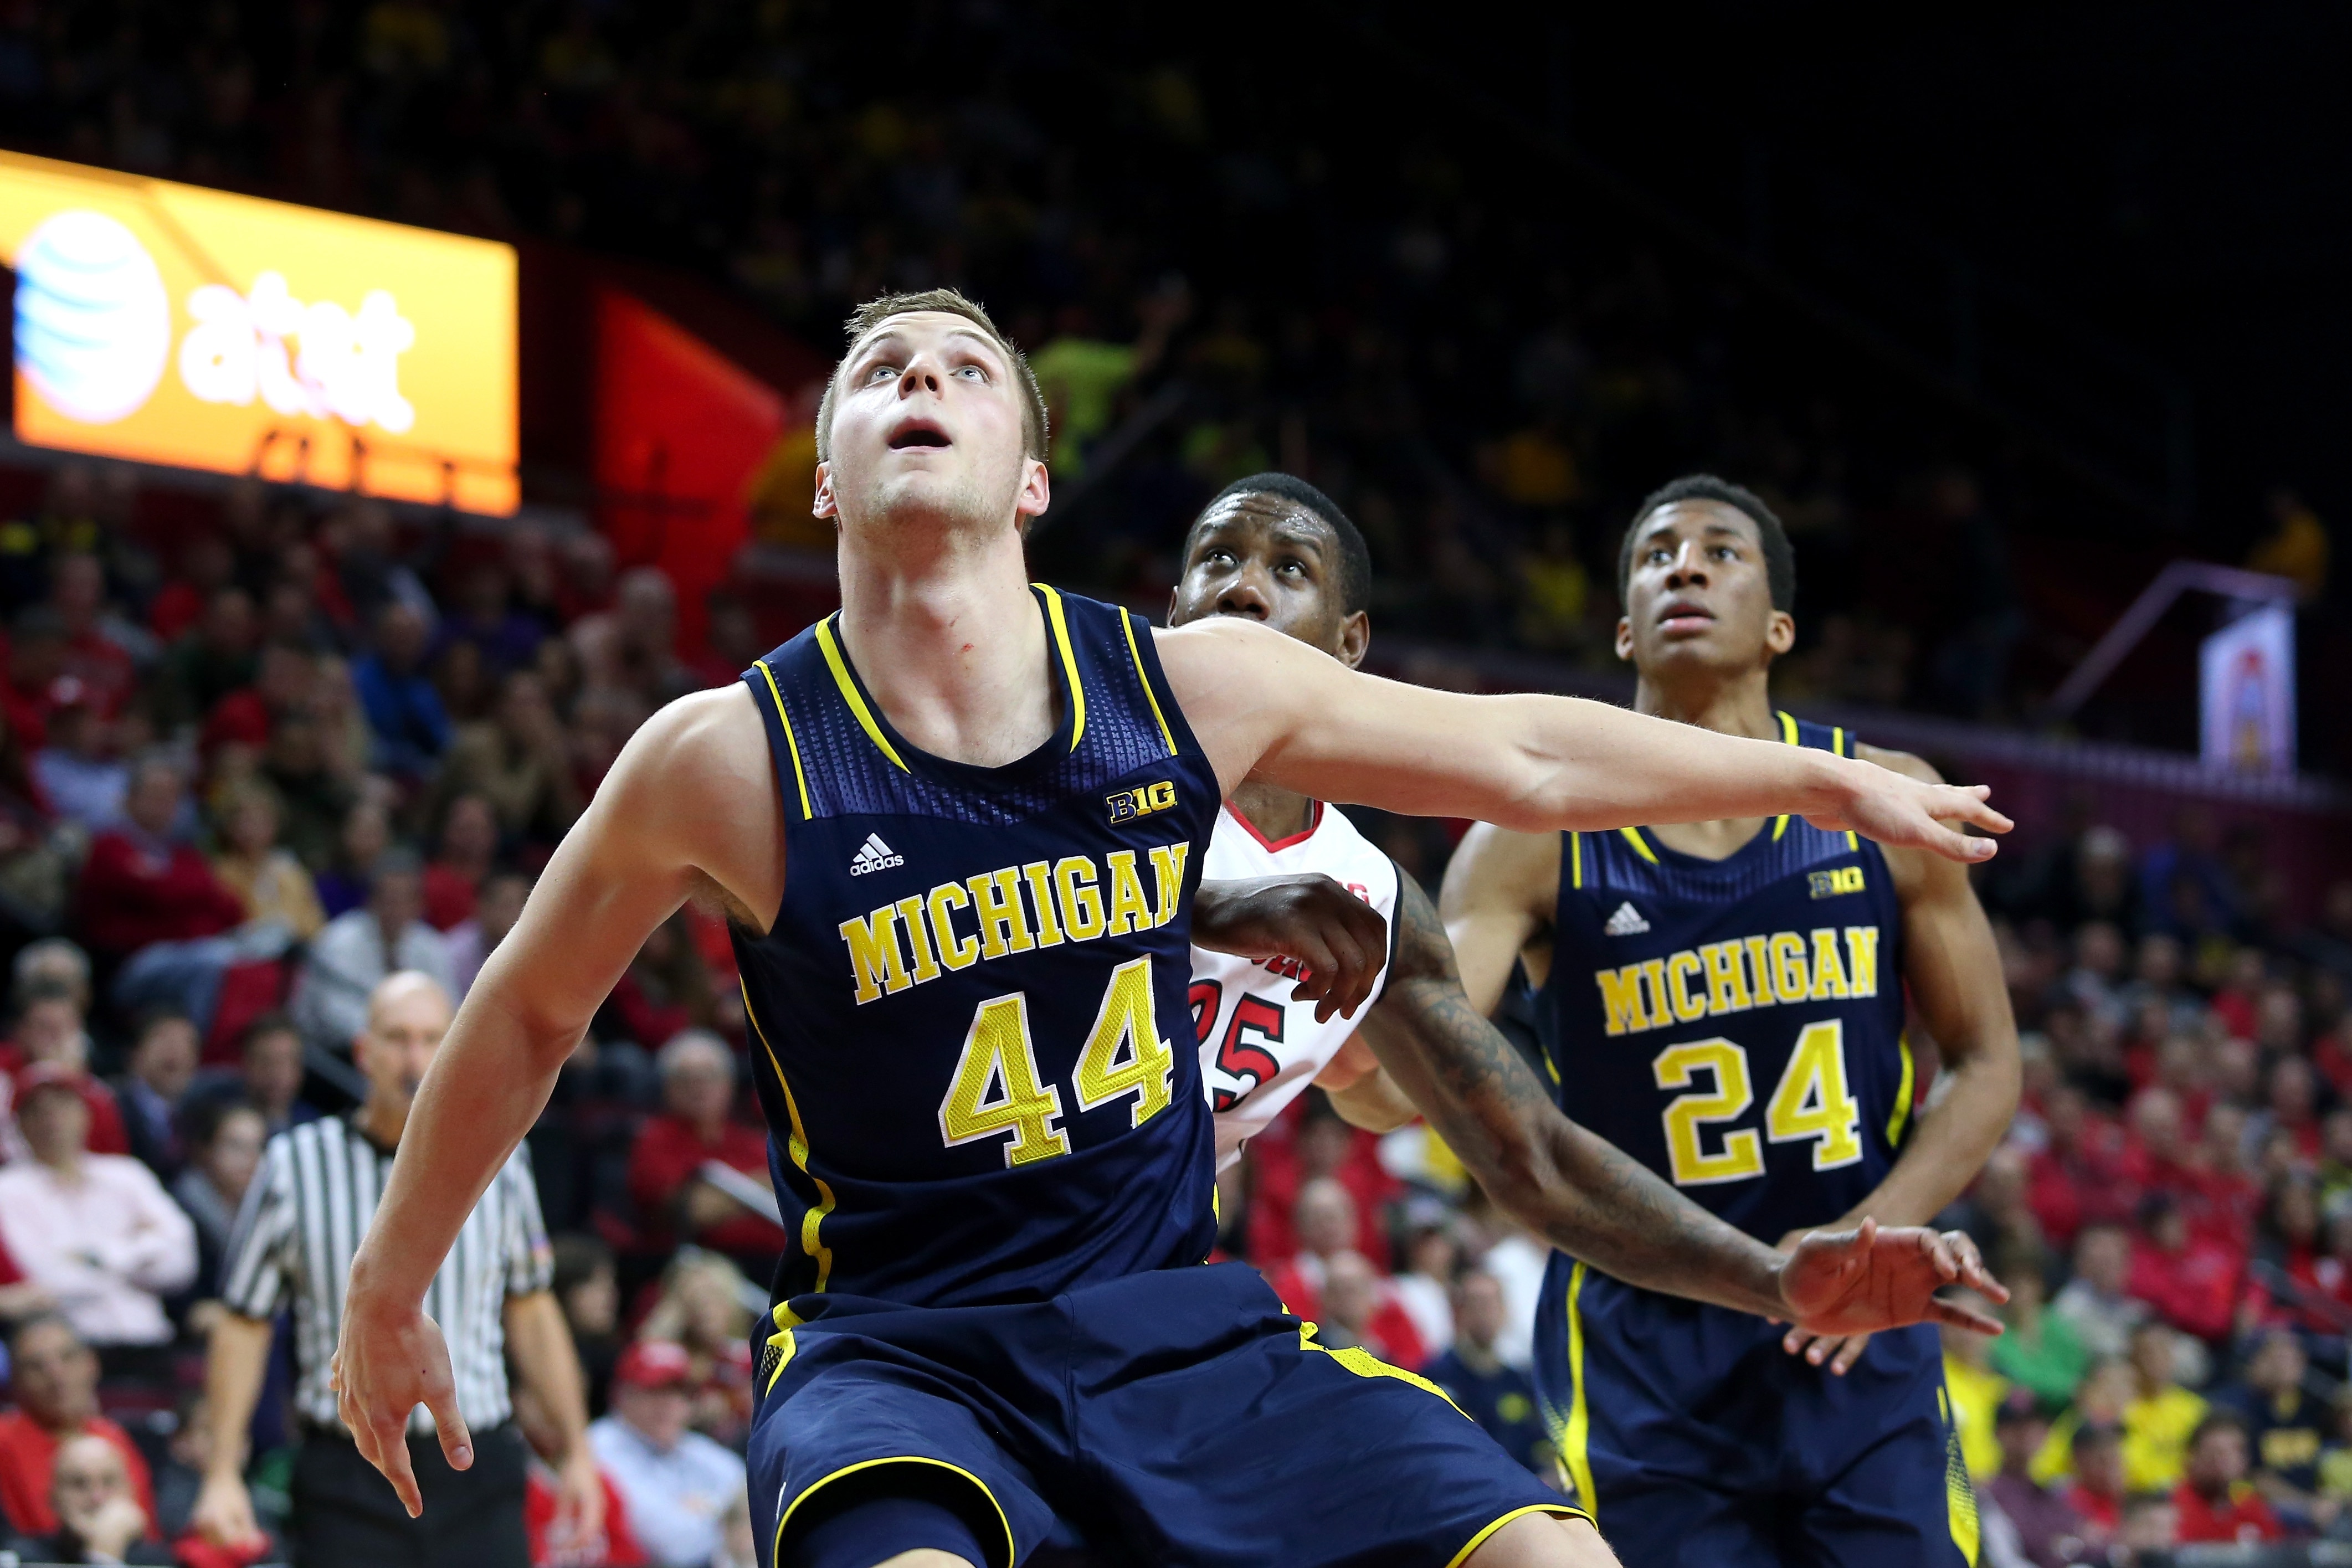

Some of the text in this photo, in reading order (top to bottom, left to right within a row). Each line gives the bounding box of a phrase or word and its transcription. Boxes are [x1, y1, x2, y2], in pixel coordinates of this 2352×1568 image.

[839, 841, 1189, 1005] MICHIGAN
[850, 855, 904, 876] adidas
[937, 953, 1174, 1170] 44
[1596, 926, 1879, 1037] MICHIGAN
[1651, 1018, 1863, 1186] 24
